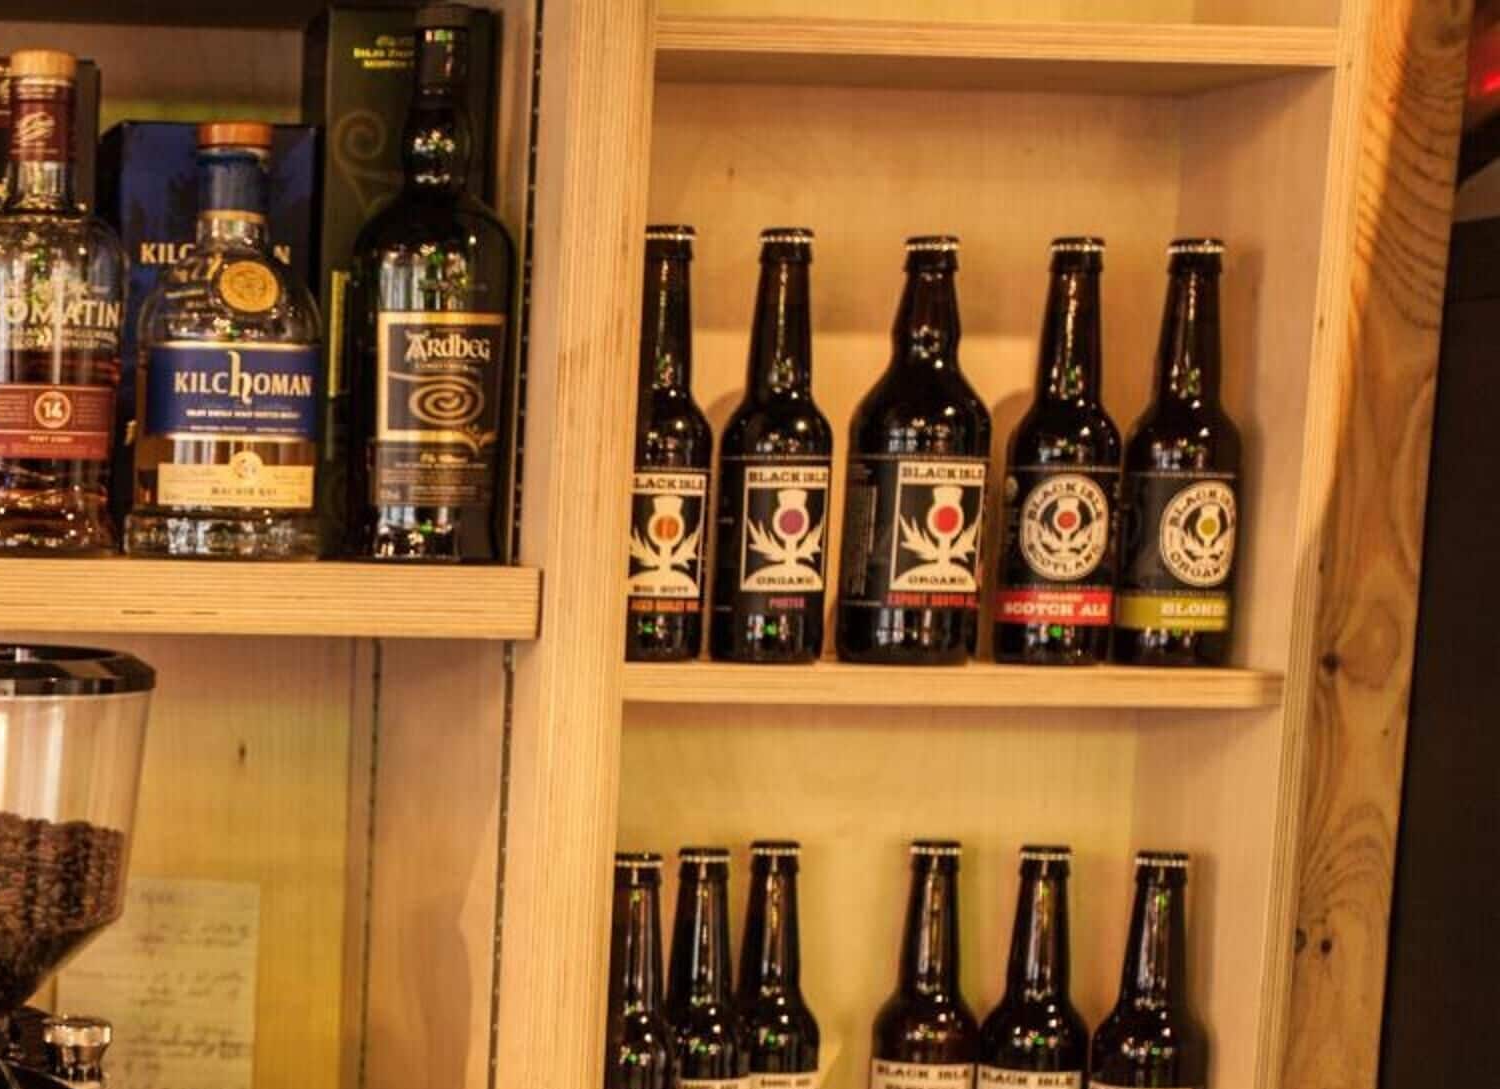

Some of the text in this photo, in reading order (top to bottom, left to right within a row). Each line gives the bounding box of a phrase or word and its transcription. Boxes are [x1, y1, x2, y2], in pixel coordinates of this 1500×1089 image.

[749, 471, 799, 482] BLACK
[902, 467, 956, 479] BLACK
[1003, 602, 1075, 618] SCOTCH
